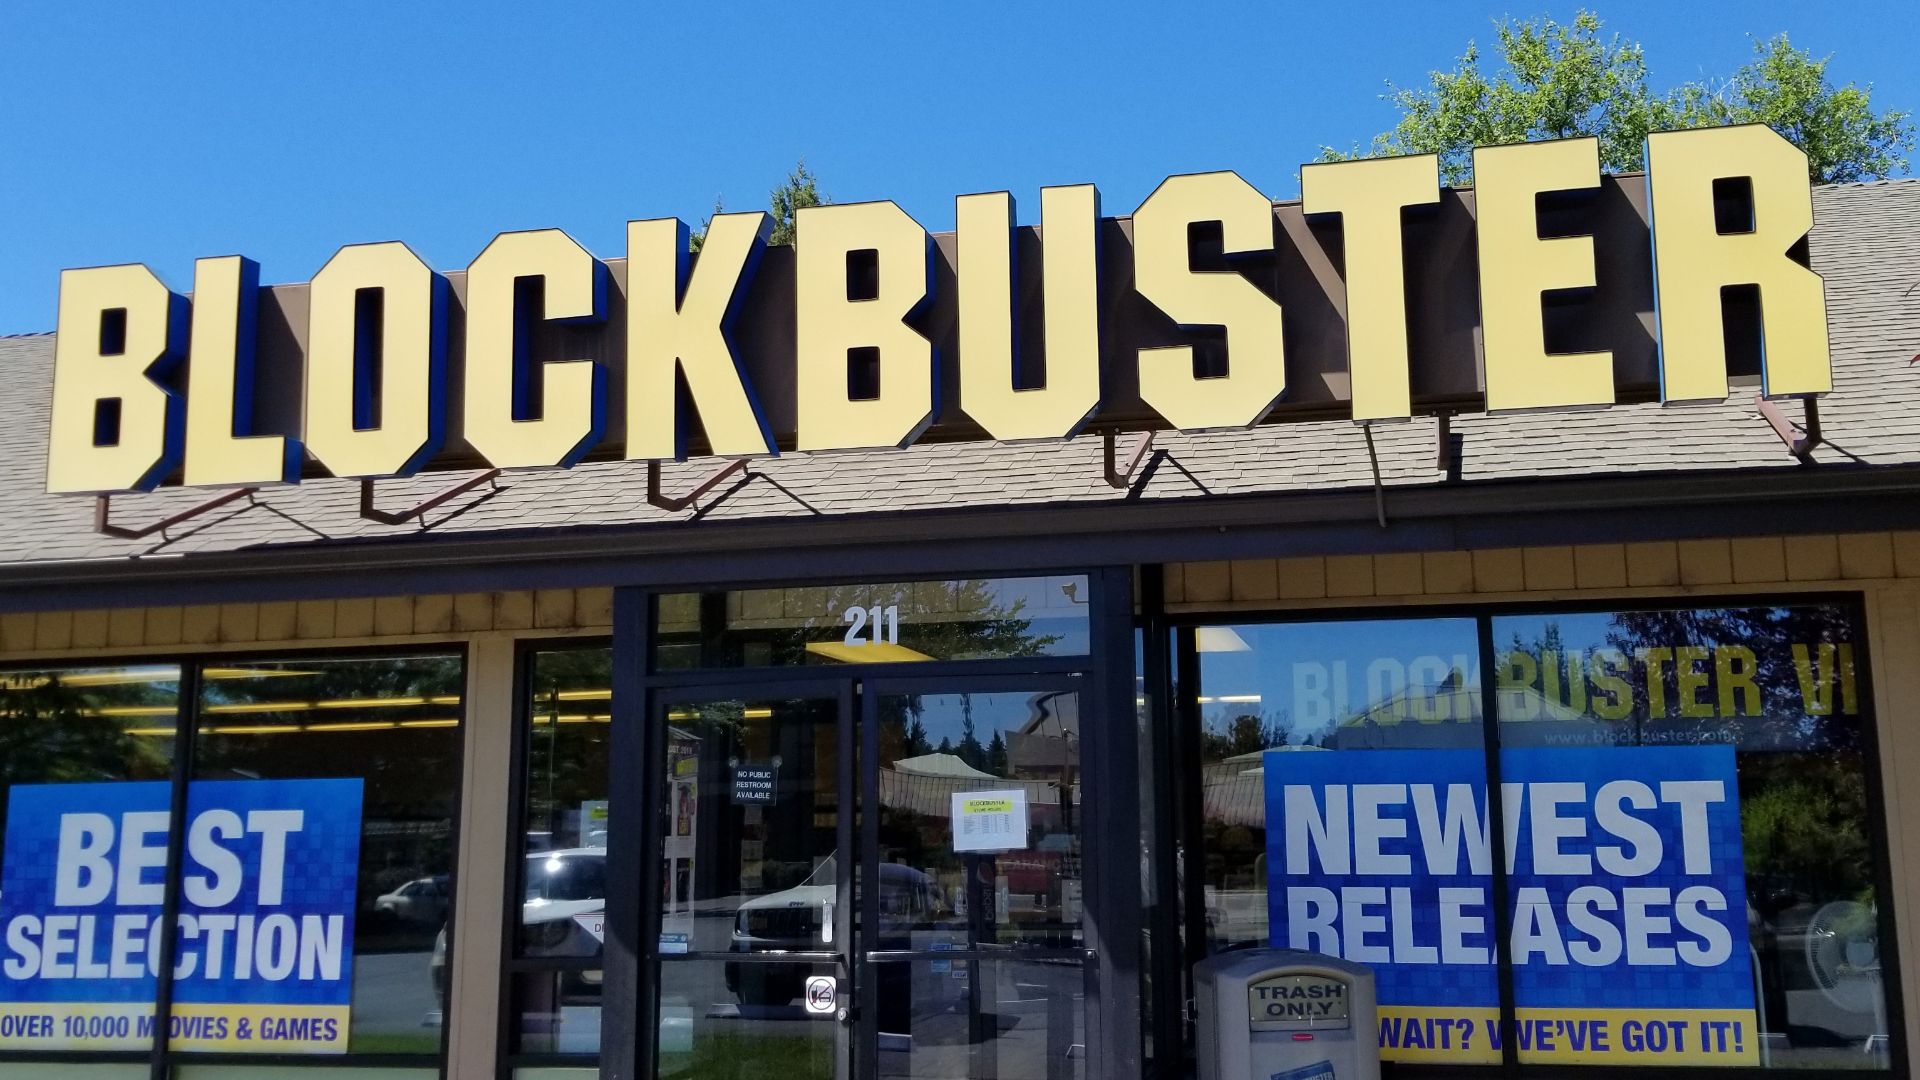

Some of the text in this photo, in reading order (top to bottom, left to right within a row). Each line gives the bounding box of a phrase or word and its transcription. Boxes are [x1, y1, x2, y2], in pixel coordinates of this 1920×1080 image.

[46, 123, 1832, 494] BLOCKBUSTER
[844, 605, 898, 646] 211
[1292, 645, 1764, 730] BLOCKBUSTER
[1544, 728, 1732, 744] www.blockbuster.com
[1284, 780, 1726, 877] NEWEST
[54, 809, 304, 908] BEST
[3, 913, 344, 981] SELECTION
[1287, 885, 1733, 967] RELEASES
[1255, 985, 1341, 999] TRASH
[1267, 1002, 1332, 1015] ONLY
[1, 1015, 338, 1042] OVER 10,000 MOVIES & GAMES
[1378, 1017, 1744, 1053] WAIT? WE'VE GOT IT!
